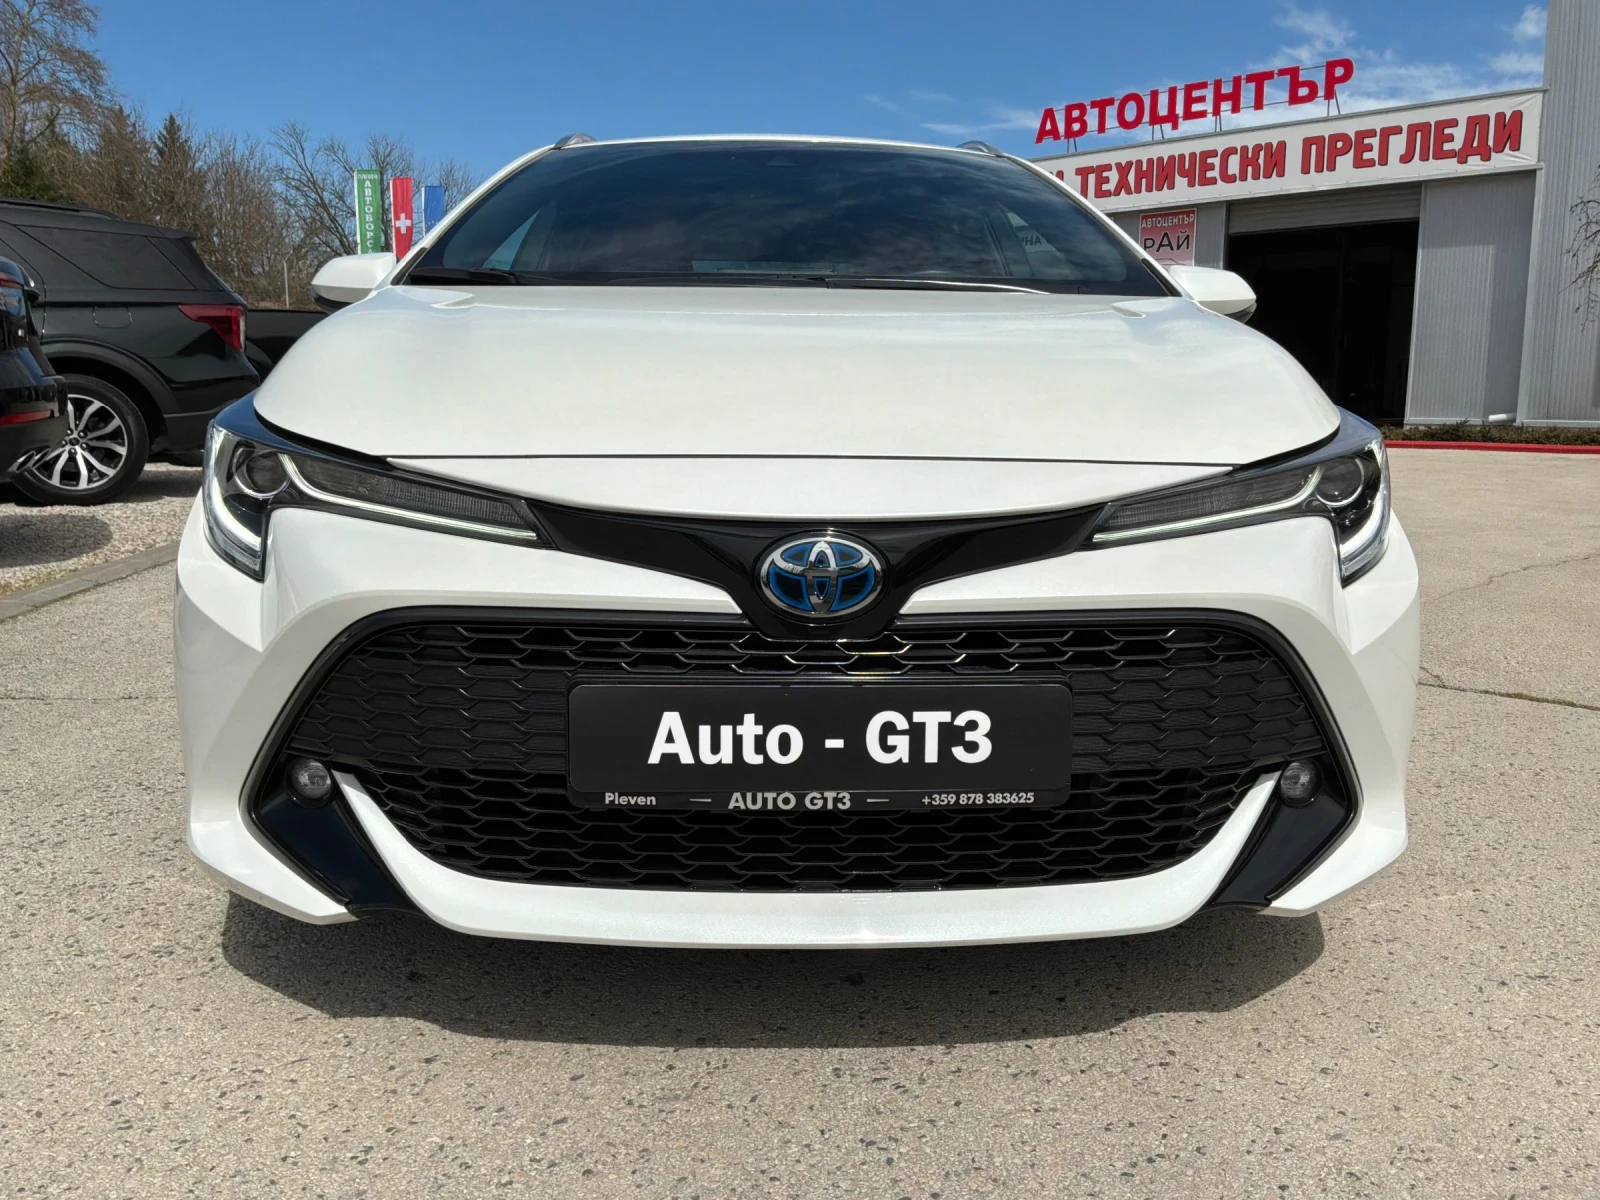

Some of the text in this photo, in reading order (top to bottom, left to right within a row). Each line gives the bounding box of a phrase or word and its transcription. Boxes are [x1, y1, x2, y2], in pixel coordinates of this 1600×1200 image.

[1035, 57, 1355, 144] АВТОЦЕНТЪР
[1074, 110, 1523, 200] ТЕХНИЧЕСКИ ПРЕГЛЕДИ
[1141, 213, 1195, 229] АВТОЦЕНТЪР
[1143, 230, 1190, 252] РАЙ
[647, 711, 804, 765] Auto
[865, 709, 993, 765] GT3
[604, 791, 657, 806] Pleven
[727, 791, 851, 810] AUTO GT3
[921, 792, 1035, 806] +359 878 383625
